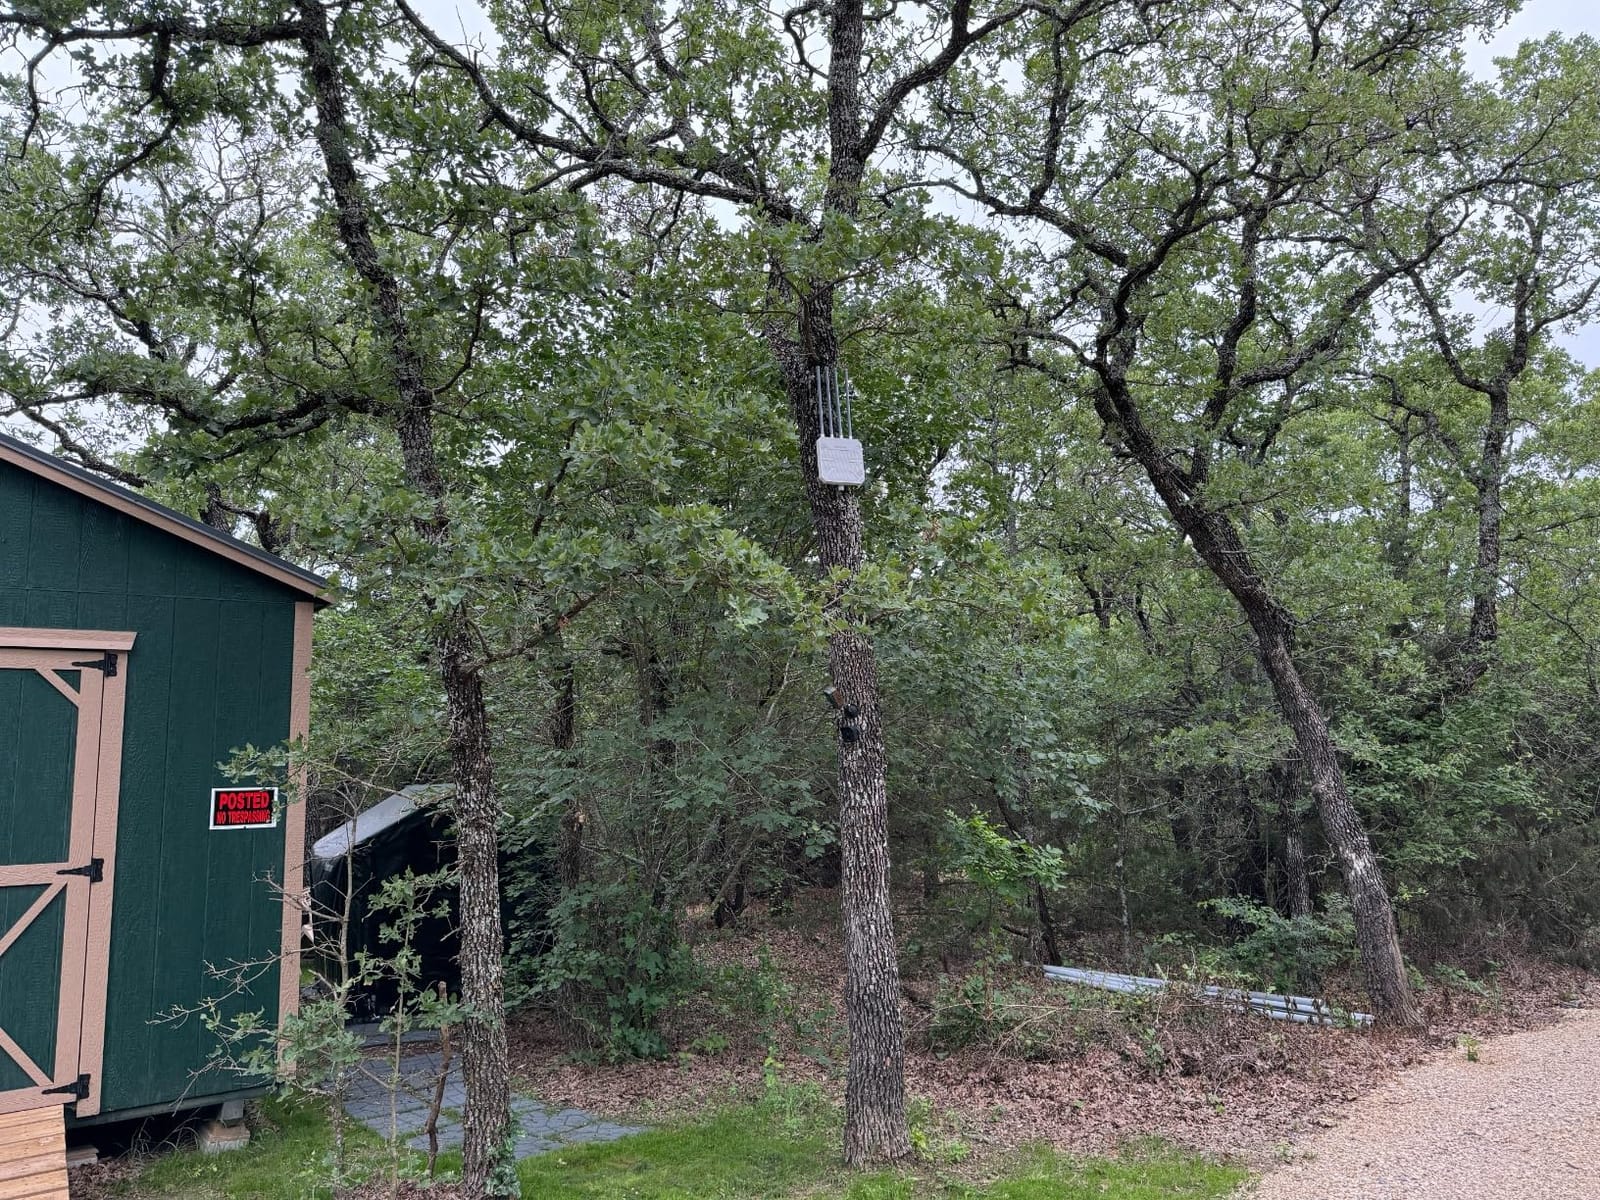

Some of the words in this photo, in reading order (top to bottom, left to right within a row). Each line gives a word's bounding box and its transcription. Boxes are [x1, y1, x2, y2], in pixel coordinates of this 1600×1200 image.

[219, 791, 269, 809] POSTED
[216, 811, 226, 824] NO
[228, 810, 270, 824] TRESPASSING
